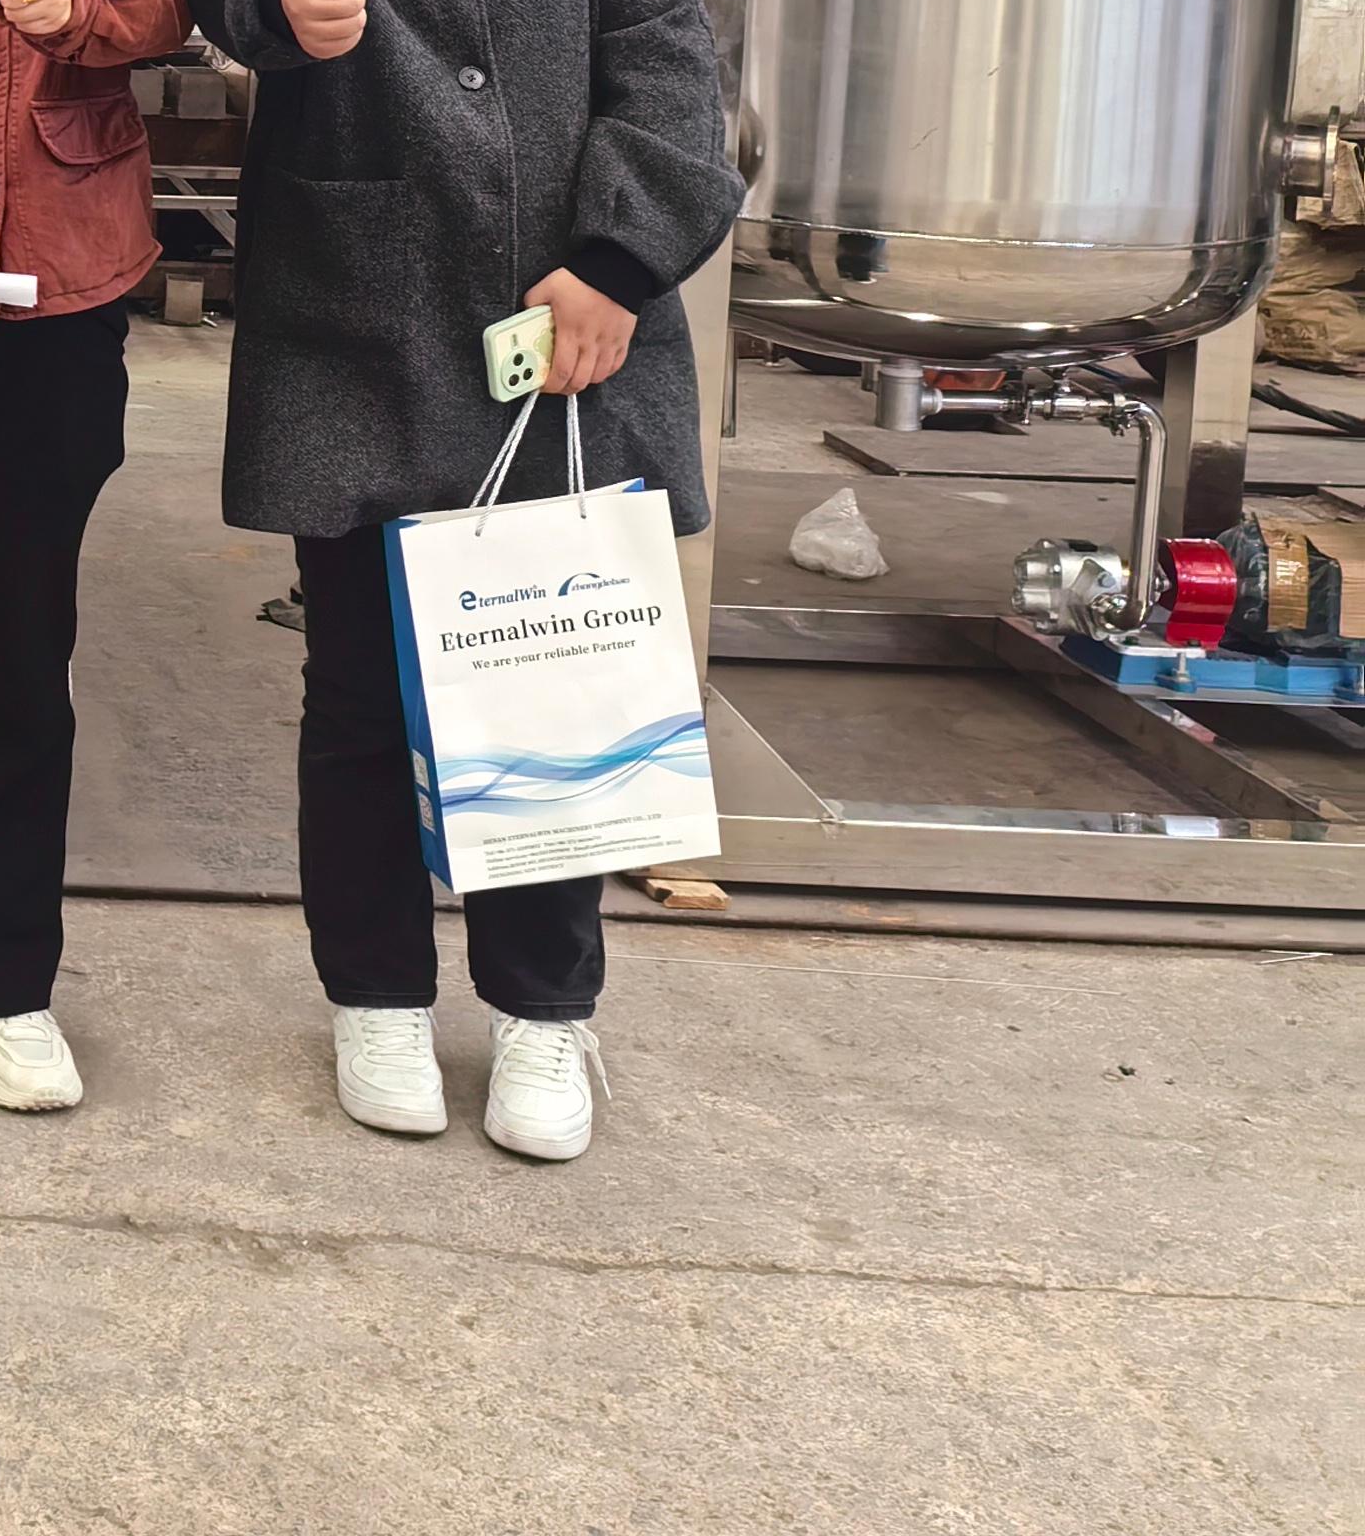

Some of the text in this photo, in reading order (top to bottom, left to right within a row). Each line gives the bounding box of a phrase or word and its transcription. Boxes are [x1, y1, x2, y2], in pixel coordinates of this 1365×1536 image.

[440, 605, 662, 652] Eternalwin Group
[472, 639, 636, 671] We are your reliable Partner
